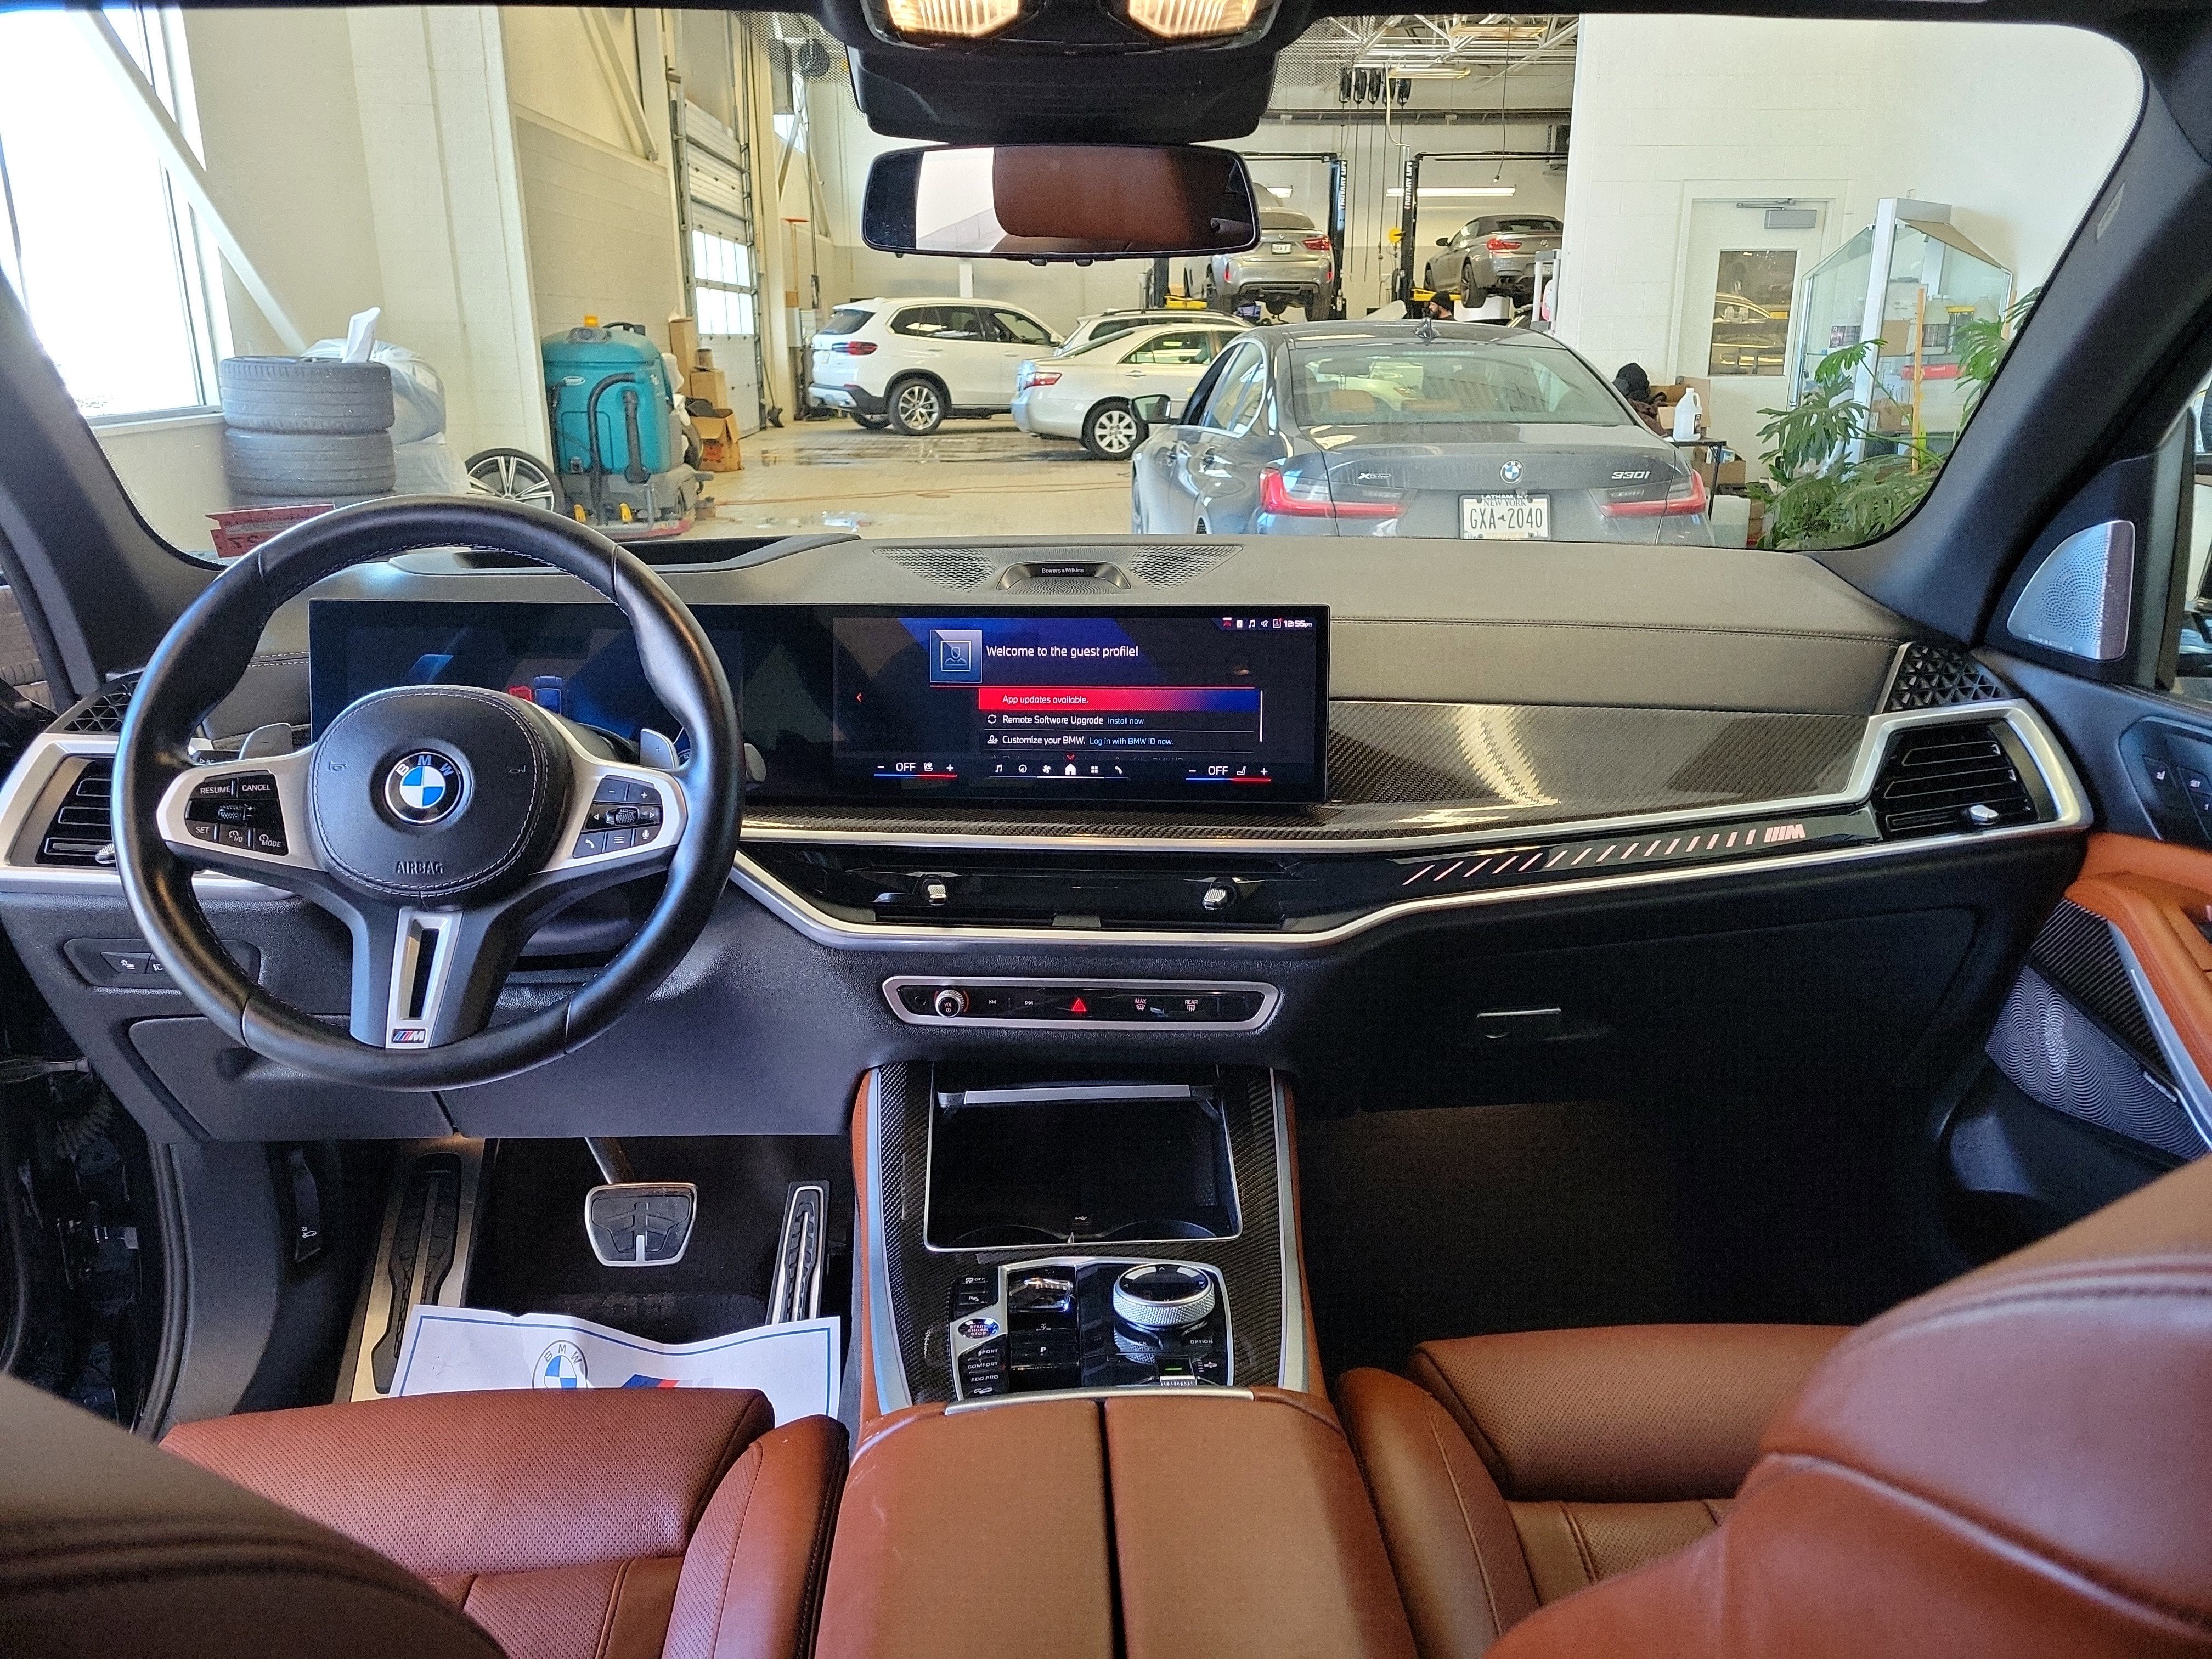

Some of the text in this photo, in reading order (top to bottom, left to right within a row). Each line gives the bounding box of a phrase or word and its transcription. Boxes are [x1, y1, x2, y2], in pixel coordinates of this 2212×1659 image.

[1470, 508, 1542, 529] GXA 2040
[986, 645, 1138, 659] Welcome to the guest profile!
[1002, 695, 1088, 705] App updates available.
[1002, 715, 1103, 726] Remote Software Upgrade
[1002, 735, 1086, 746] Customize your BMW.
[1090, 737, 1102, 746] Log
[395, 755, 455, 777] BMW
[896, 762, 916, 771] OFF
[1208, 765, 1229, 775] OFF
[200, 786, 231, 794] RESUME
[261, 839, 282, 848] MODE
[396, 861, 444, 874] AIRBAG
[543, 1344, 583, 1365] BMW
[968, 1361, 998, 1369] COMFORT
